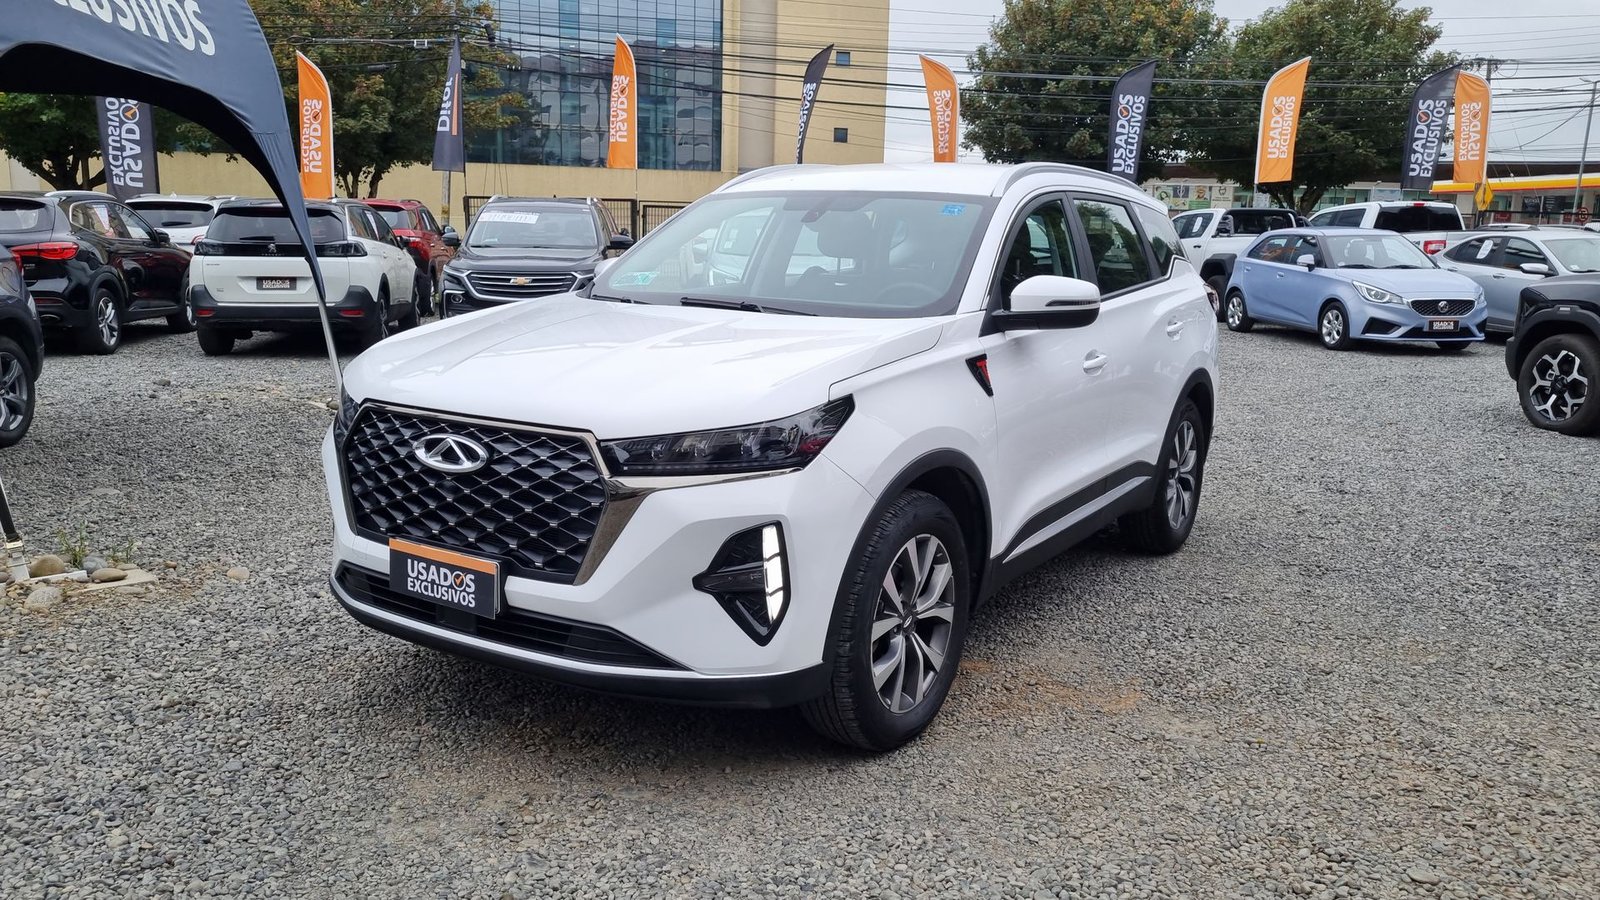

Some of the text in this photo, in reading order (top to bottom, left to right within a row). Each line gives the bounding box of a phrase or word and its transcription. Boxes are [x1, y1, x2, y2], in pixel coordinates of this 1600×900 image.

[1112, 94, 1134, 172] USADOS
[1124, 95, 1145, 174] EXCLUSIVOS
[1267, 96, 1286, 159] USADOS
[1279, 96, 1296, 158] EXCLUSIVOS
[1408, 100, 1435, 177] USADOS
[1419, 100, 1447, 177] EXCLUSIVOS
[407, 558, 476, 593] USADOS
[407, 577, 476, 608] EXCLUSIVOS
